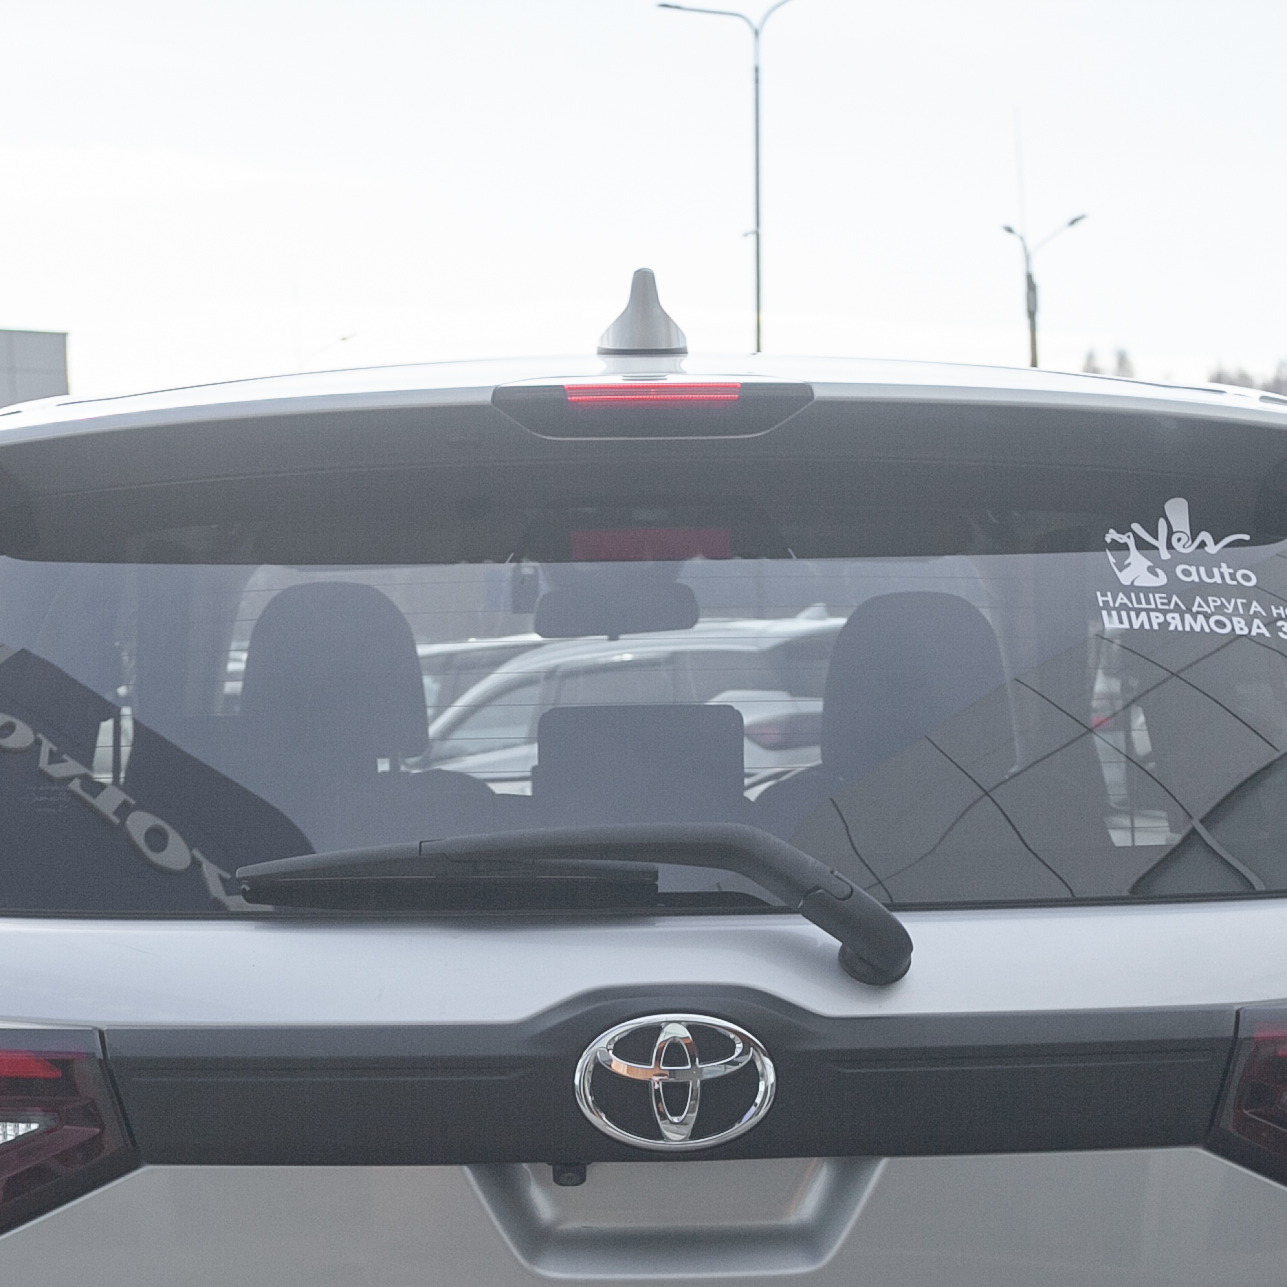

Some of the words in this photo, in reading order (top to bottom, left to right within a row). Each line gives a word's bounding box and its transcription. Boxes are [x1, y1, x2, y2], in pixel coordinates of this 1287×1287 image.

[1175, 562, 1258, 588] auto
[1096, 591, 1187, 611] НАШЕЛ
[1191, 595, 1267, 617] ДРУГА
[1101, 609, 1272, 638] ШИРЯМОВА
